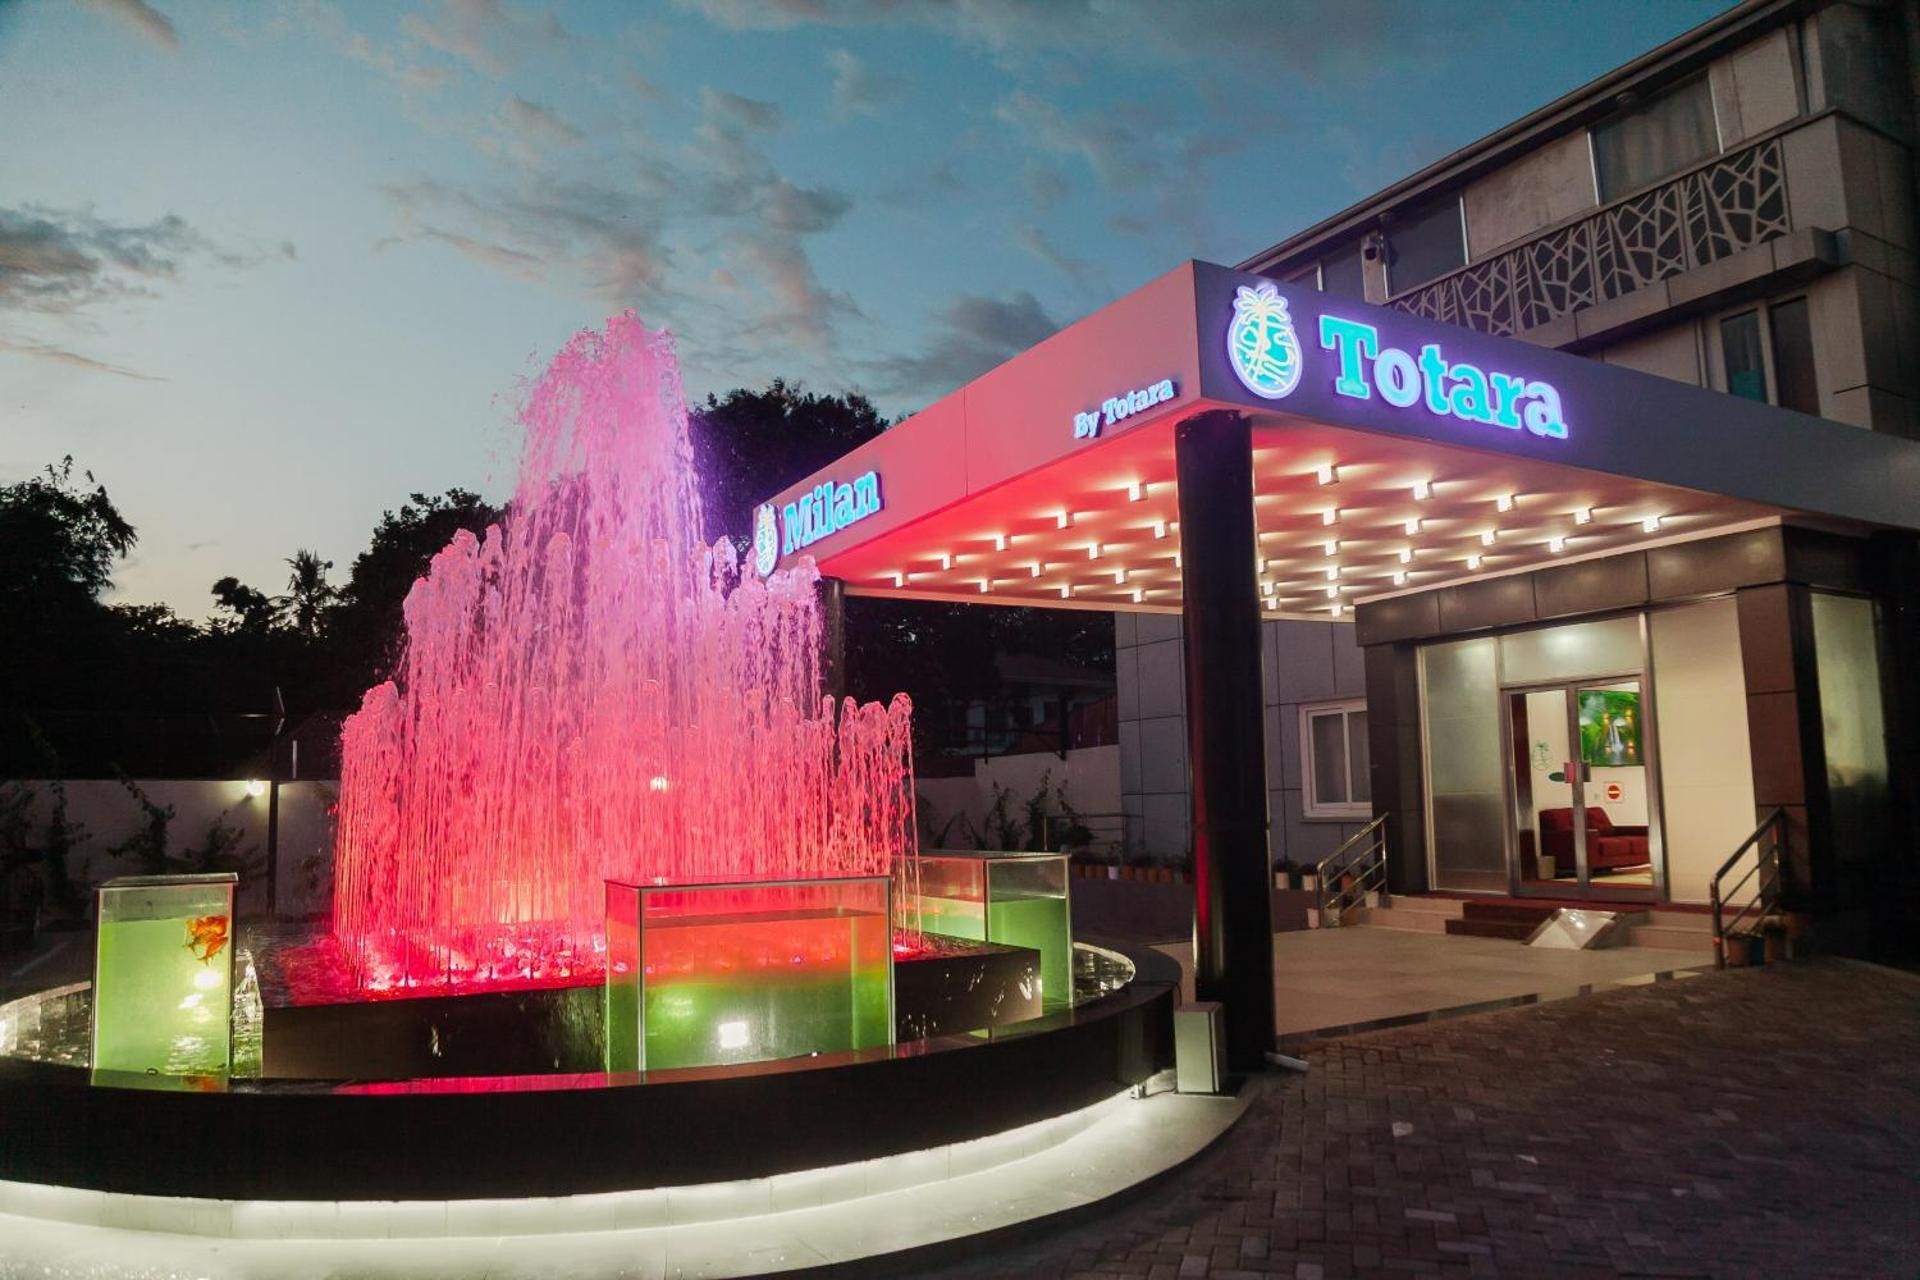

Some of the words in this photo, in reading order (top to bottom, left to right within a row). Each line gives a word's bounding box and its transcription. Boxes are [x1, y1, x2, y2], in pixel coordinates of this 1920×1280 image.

[1073, 411, 1100, 439] By
[1102, 379, 1176, 425] Totara
[1319, 315, 1569, 440] Totara
[783, 470, 883, 555] Milan
